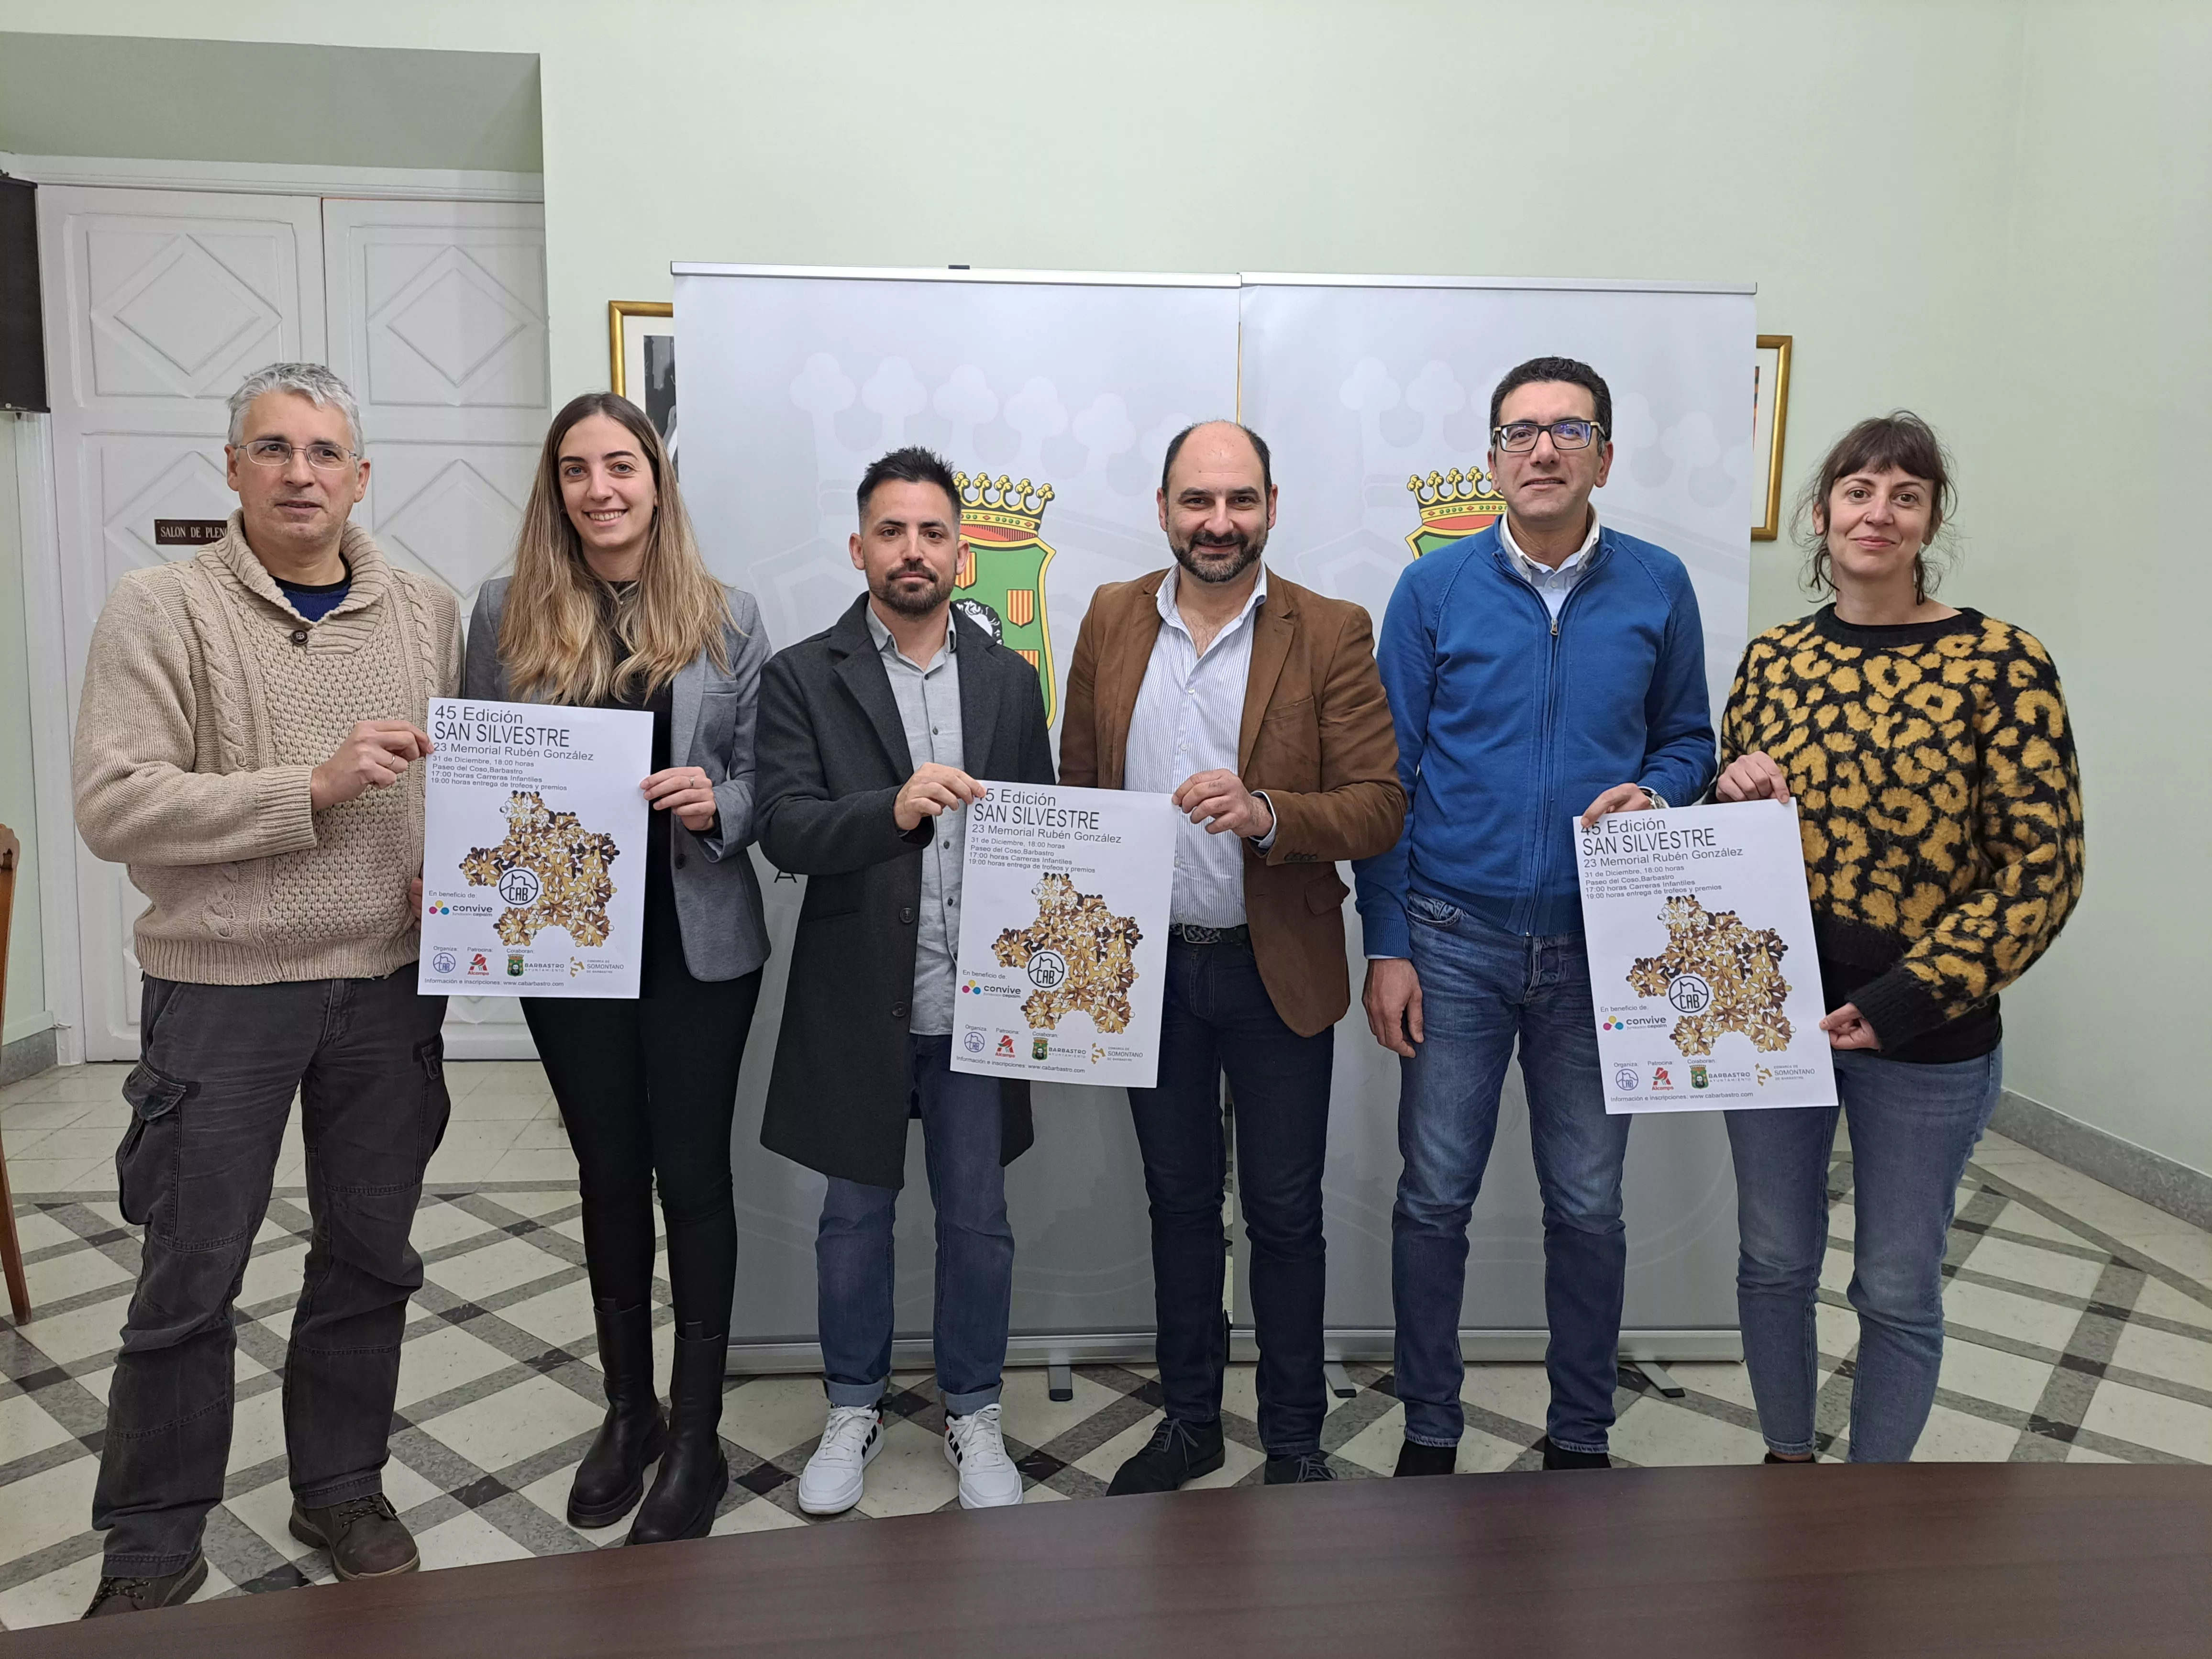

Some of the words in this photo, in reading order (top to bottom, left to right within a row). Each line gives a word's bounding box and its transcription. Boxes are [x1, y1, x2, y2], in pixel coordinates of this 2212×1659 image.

[160, 526, 186, 538] SALON
[190, 527, 201, 538] DE
[434, 705, 456, 720] 45
[463, 707, 522, 724] Edición
[434, 721, 470, 741] SAN
[476, 724, 570, 748] SILVESTRE
[433, 742, 447, 752] 23
[451, 743, 501, 755] Memorial
[505, 746, 540, 758] Rubén
[543, 749, 594, 761] González
[454, 756, 491, 765] Diciembre,
[975, 788, 995, 802] 5
[1001, 789, 1056, 807] Edición
[973, 803, 1007, 823] SAN
[1012, 806, 1100, 830] SILVESTRE
[1607, 817, 1666, 834] Edición
[972, 824, 984, 833] 23
[988, 825, 1034, 837] Memorial
[1038, 829, 1071, 840] Rubén
[1074, 831, 1122, 843] González
[991, 838, 1025, 847] Diciembre,
[1582, 836, 1617, 856] SAN
[1622, 828, 1716, 853] SILVESTRE
[1042, 857, 1073, 865] Infantiles
[1583, 858, 1597, 868] 23
[1600, 854, 1649, 867] Memorial
[1652, 852, 1688, 863] Rubén
[1692, 847, 1743, 859] González
[509, 886, 529, 901] CAB
[1694, 885, 1722, 893] premios
[452, 904, 493, 913] convive
[972, 971, 997, 979] beneficio
[1036, 969, 1055, 984] CAB
[984, 985, 1021, 995] convive
[1679, 994, 1700, 1009] CAB
[1626, 1016, 1667, 1025] convive
[956, 1055, 986, 1064] Información
